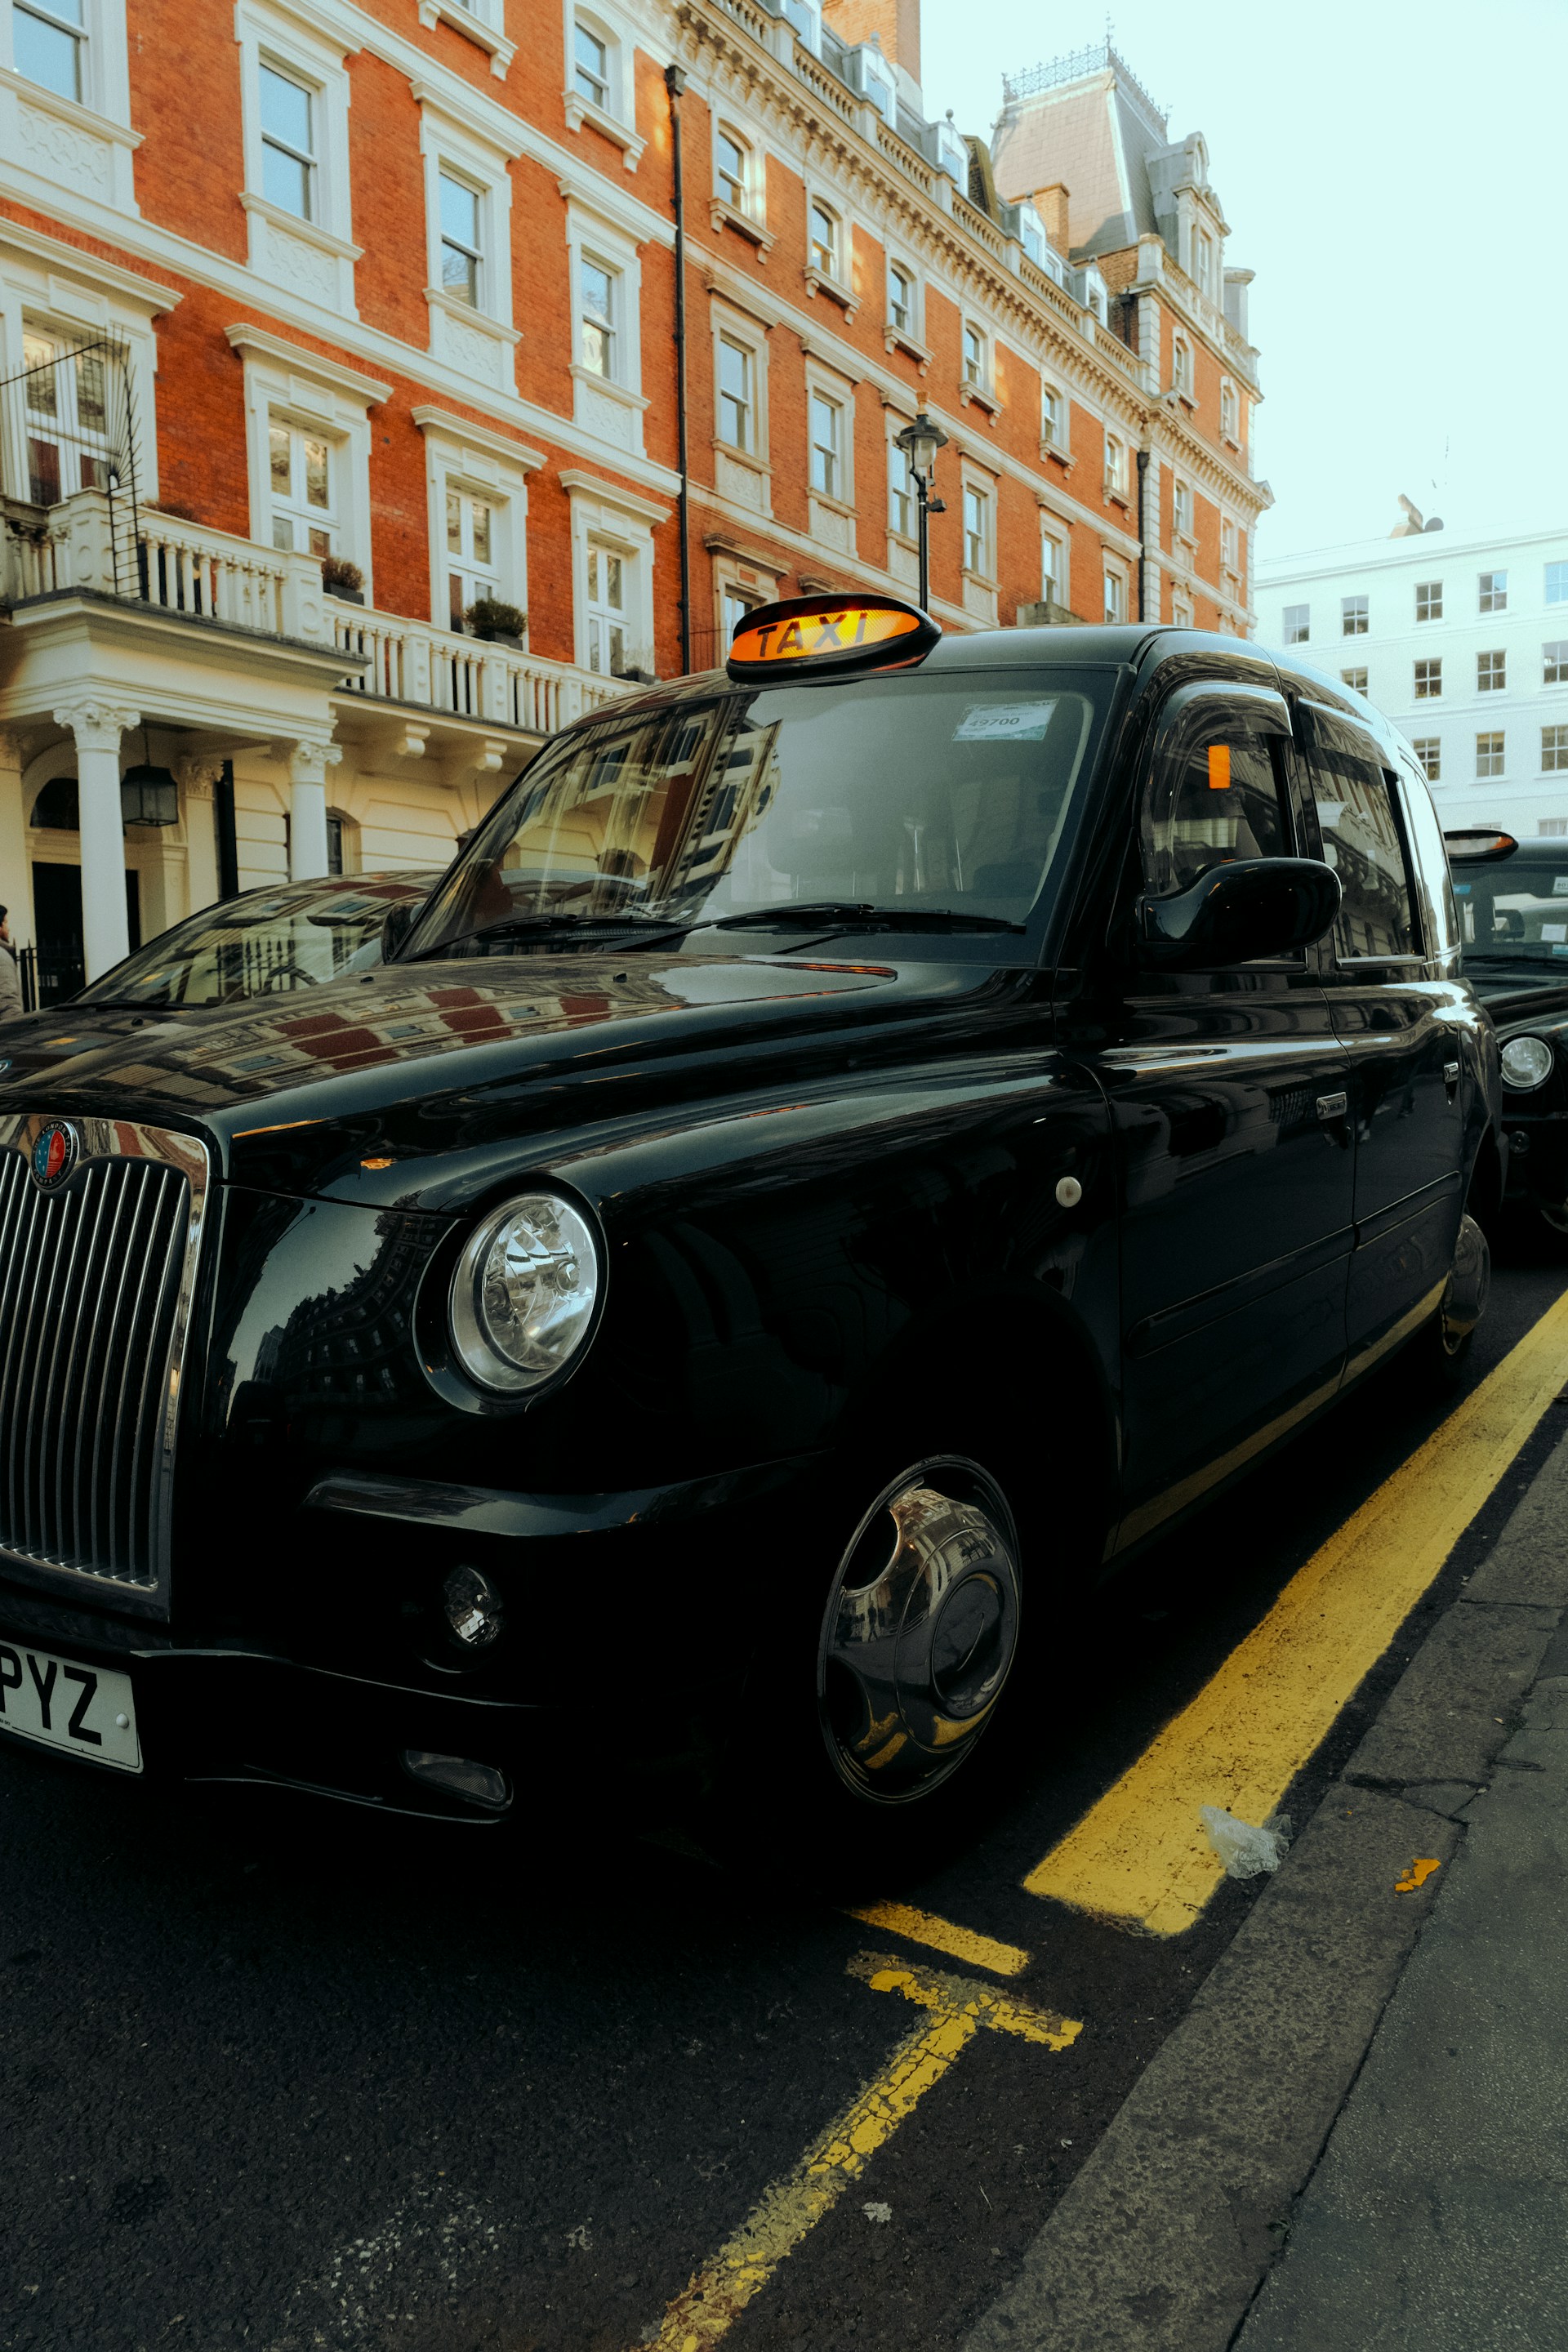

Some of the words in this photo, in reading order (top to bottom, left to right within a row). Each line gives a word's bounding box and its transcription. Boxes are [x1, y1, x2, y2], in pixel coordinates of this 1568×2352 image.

[757, 612, 867, 657] TAXI
[968, 717, 1020, 727] 49700
[42, 1123, 67, 1134] LONDON
[33, 1169, 62, 1184] COMPANY
[0, 1643, 102, 1746] PYZ
